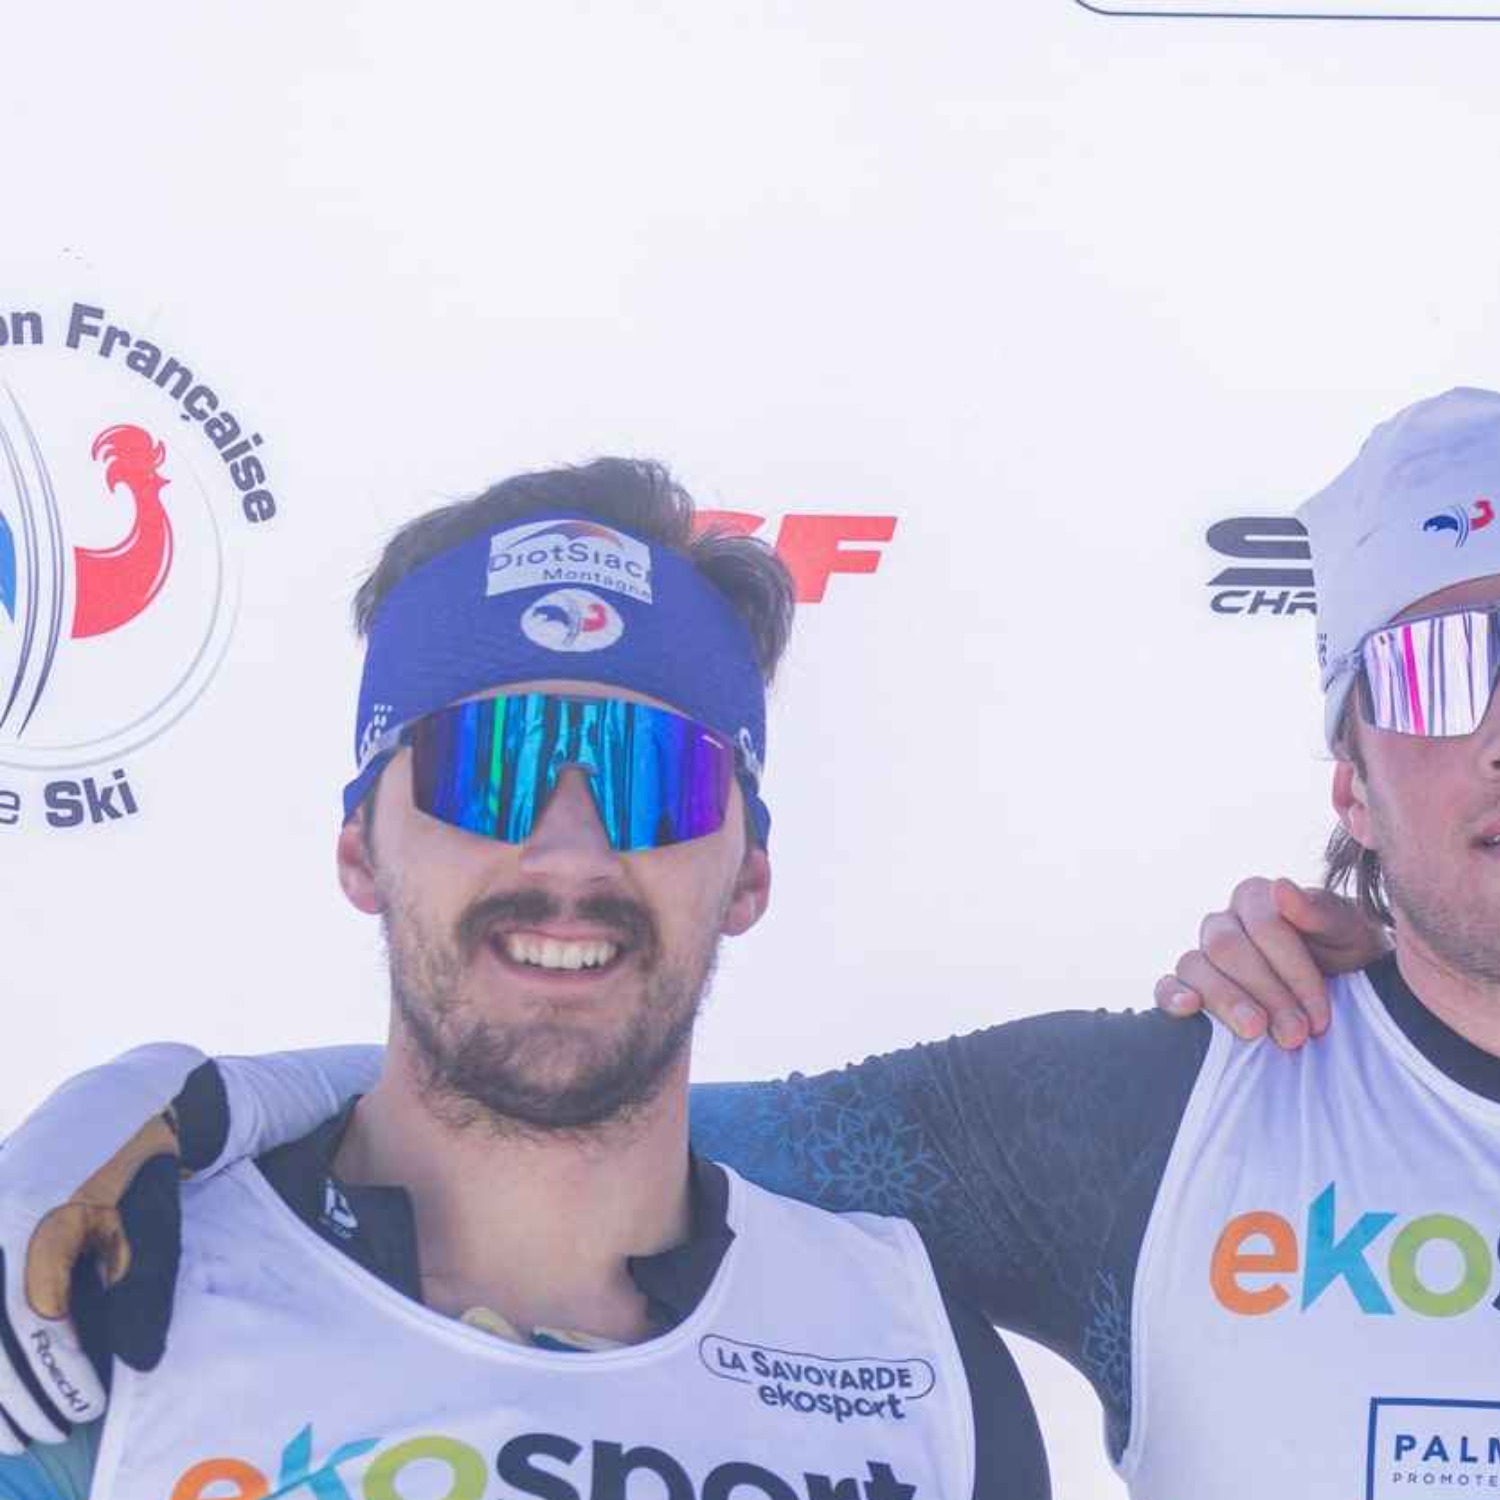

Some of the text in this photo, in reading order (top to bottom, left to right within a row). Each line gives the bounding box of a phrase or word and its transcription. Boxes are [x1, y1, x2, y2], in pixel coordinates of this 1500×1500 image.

[0, 302, 277, 523] n Française
[44, 768, 139, 828] Ski
[715, 1346, 914, 1392] LA SAVOYARDE
[757, 1382, 906, 1423] ekosport
